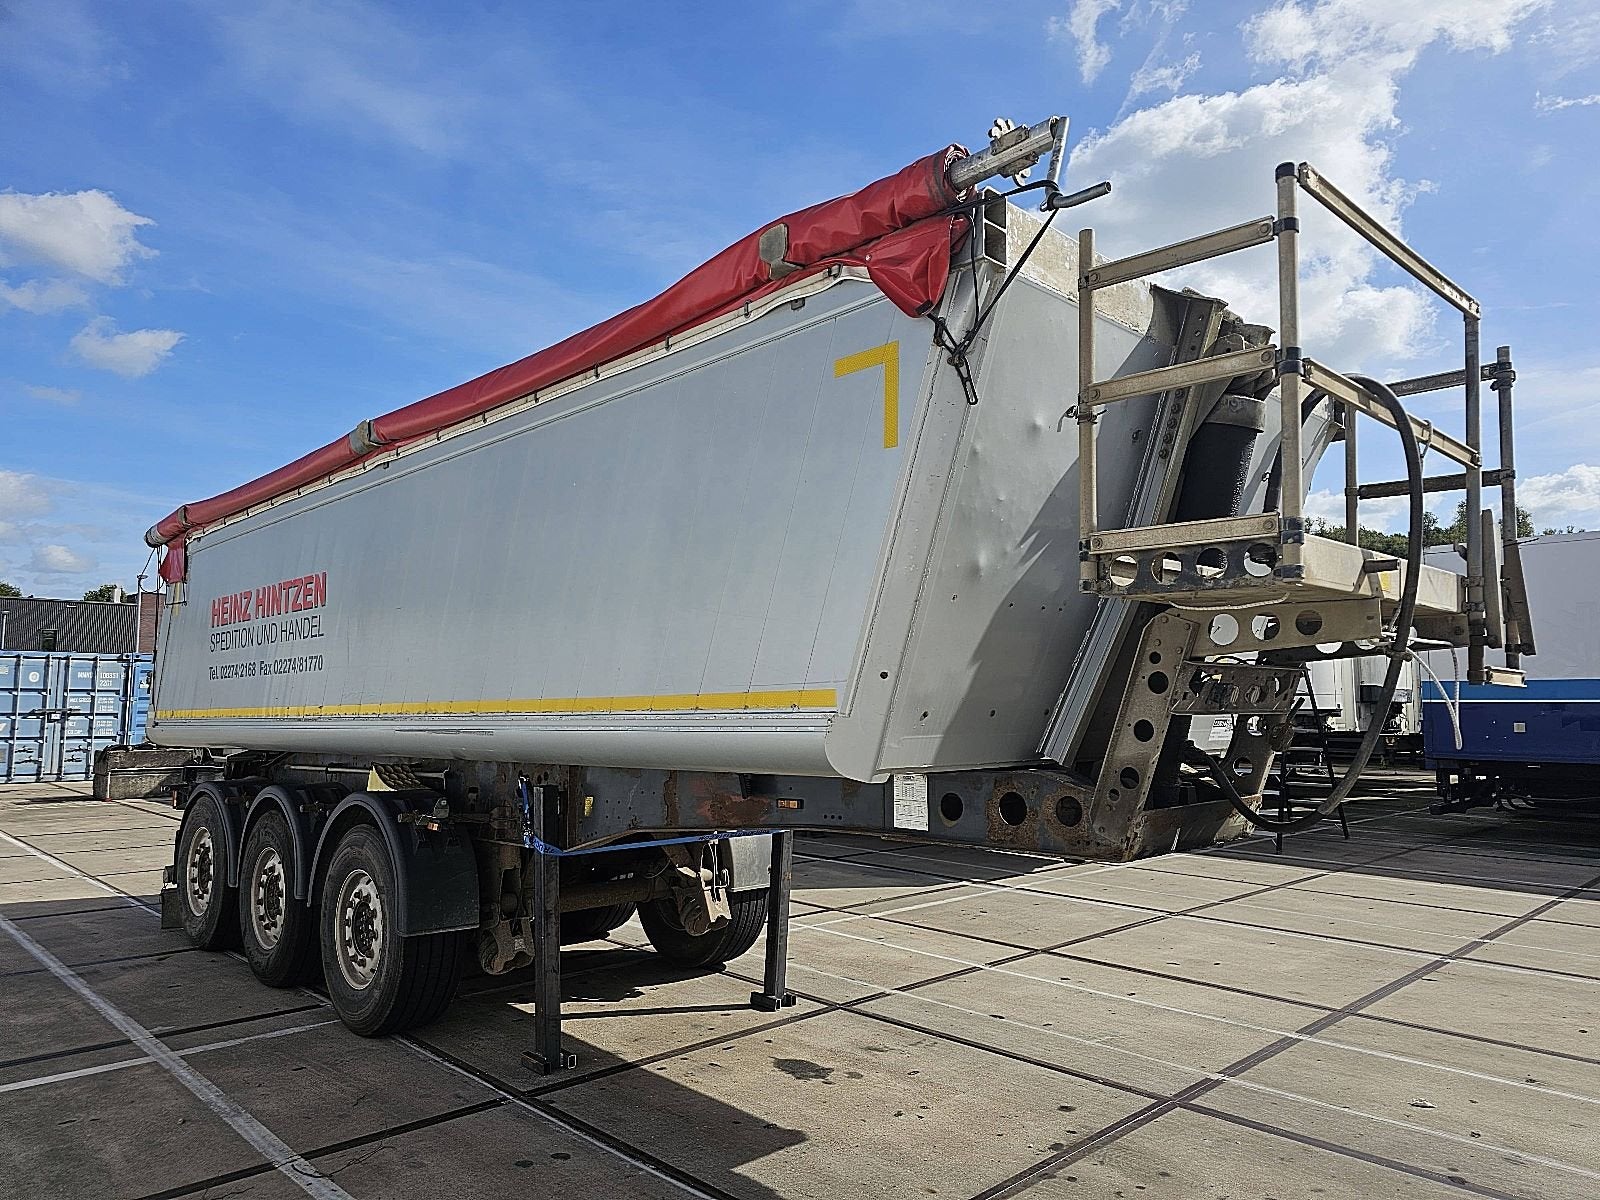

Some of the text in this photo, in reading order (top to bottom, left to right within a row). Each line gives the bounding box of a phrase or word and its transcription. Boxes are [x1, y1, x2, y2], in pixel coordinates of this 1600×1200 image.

[211, 571, 327, 629] HEINZ HINTZEN
[209, 614, 325, 653] SPEDITION UND HANDEL
[260, 660, 272, 676] Fax
